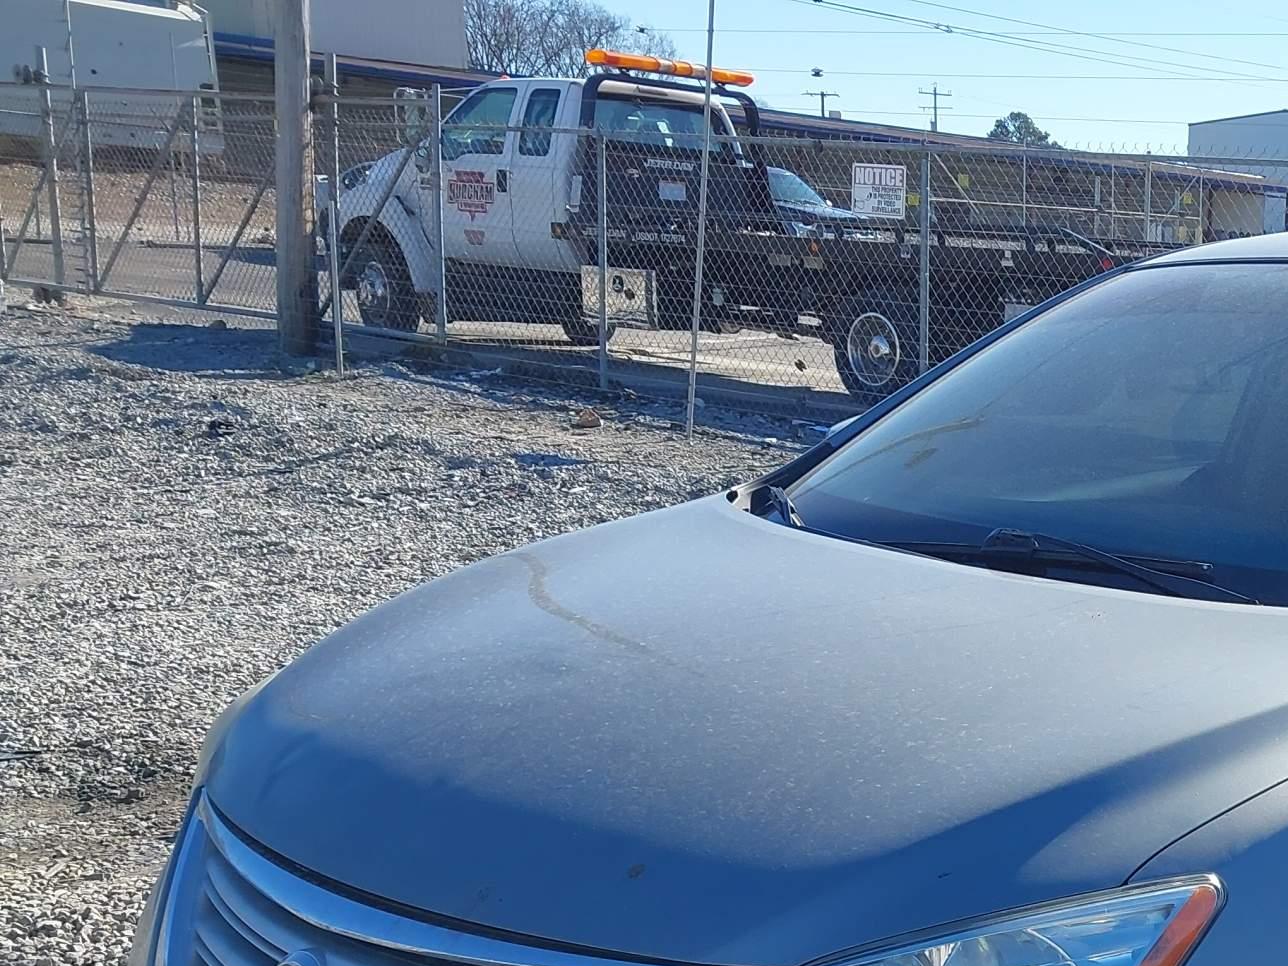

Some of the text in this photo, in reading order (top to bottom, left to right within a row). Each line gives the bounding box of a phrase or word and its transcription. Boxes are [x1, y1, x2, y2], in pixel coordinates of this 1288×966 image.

[855, 167, 903, 186] NOTICE
[878, 193, 902, 201] PROTECTED
[871, 206, 901, 214] SURVEILLANCE
